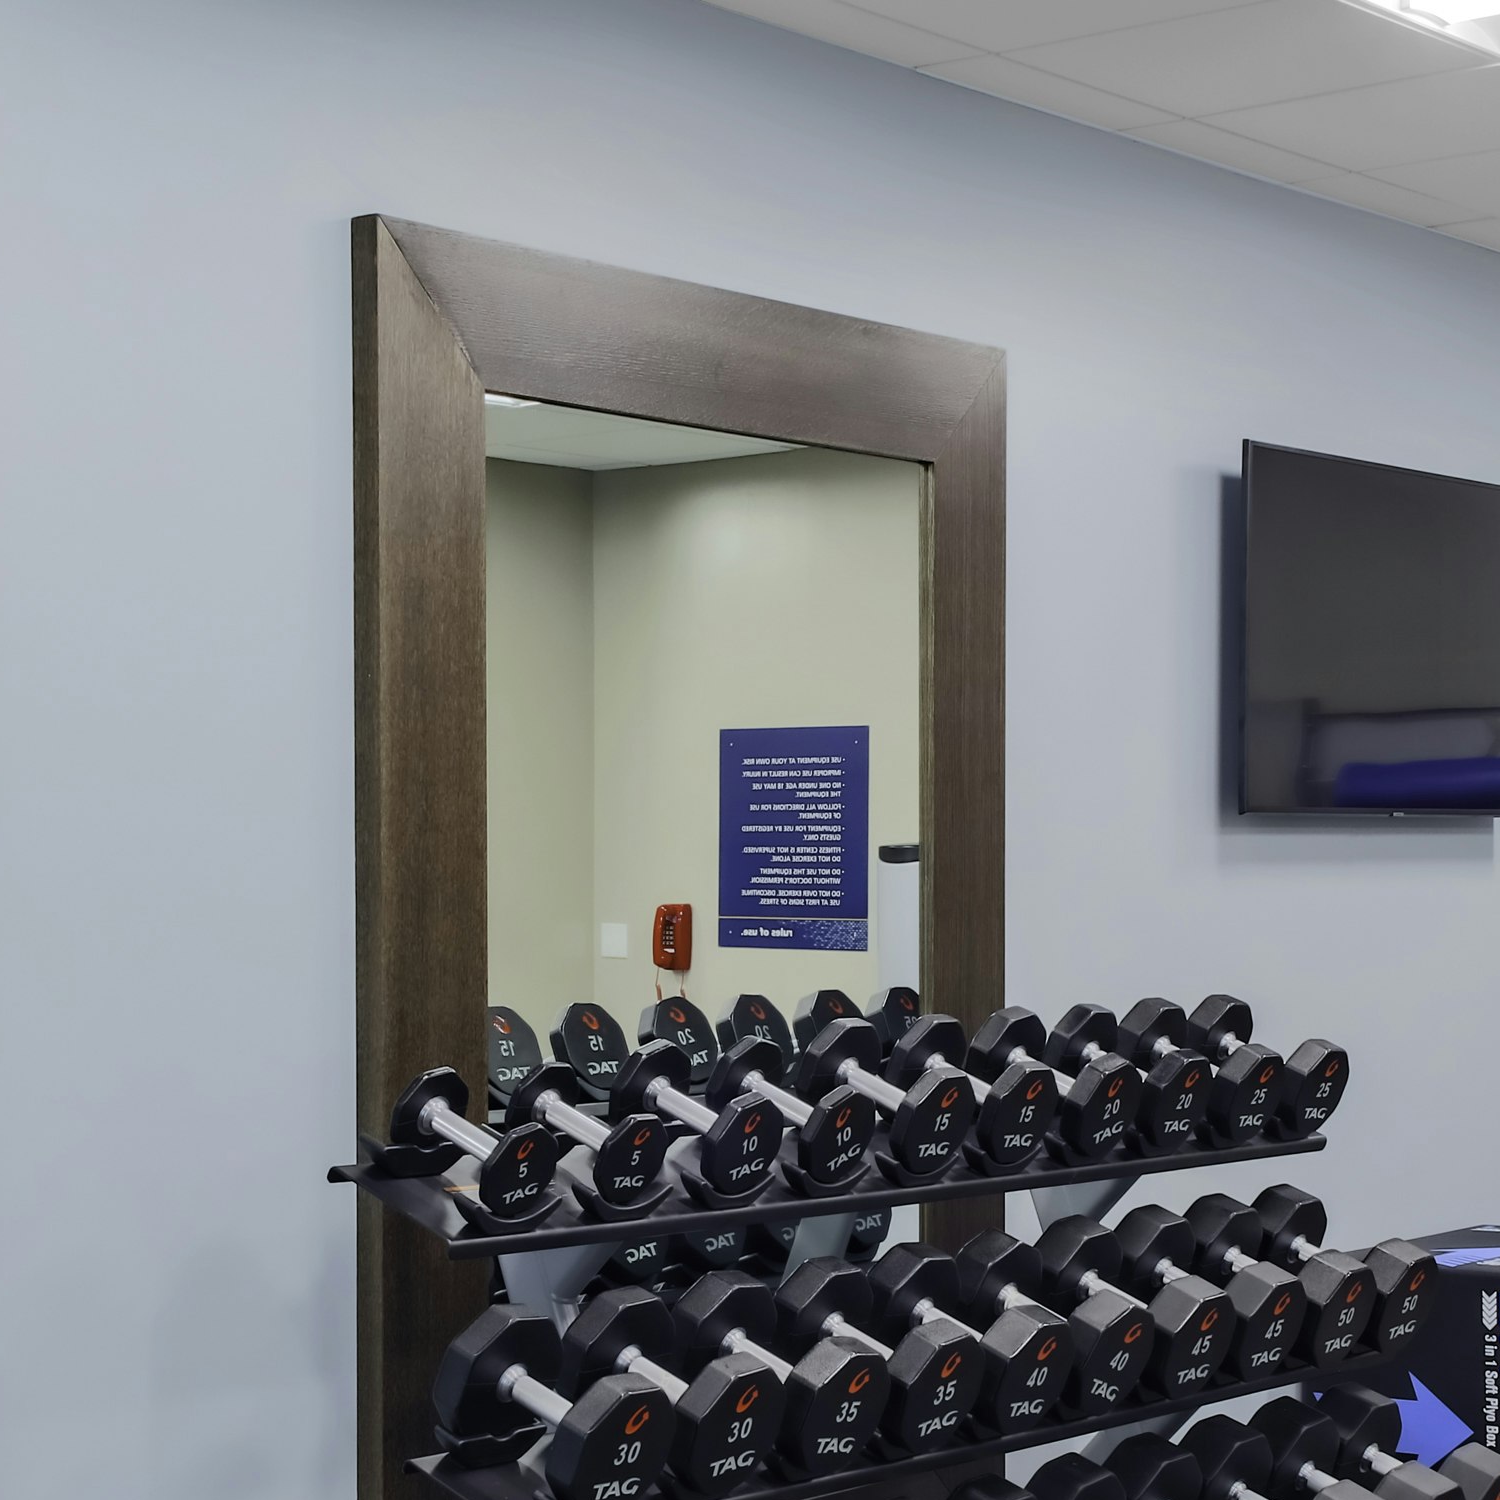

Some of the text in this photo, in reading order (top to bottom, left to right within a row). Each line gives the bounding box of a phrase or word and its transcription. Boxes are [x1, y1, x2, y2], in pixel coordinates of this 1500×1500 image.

[1251, 1088, 1267, 1104] 25
[1316, 1083, 1332, 1098] 25
[1103, 1099, 1121, 1120] 20
[1176, 1093, 1193, 1109] 20
[934, 1113, 951, 1132] 15
[1019, 1105, 1035, 1123] 15
[1239, 1113, 1263, 1127] TAG
[1304, 1107, 1327, 1119] TAG
[1093, 1120, 1124, 1144] TAG
[1164, 1119, 1190, 1133] TAG
[743, 1136, 758, 1154] 10
[837, 1127, 851, 1146] 10
[1004, 1134, 1033, 1148] TAG
[631, 1150, 642, 1165] 5
[827, 1144, 860, 1171] TAG
[918, 1142, 949, 1157] TAG
[519, 1162, 527, 1178] 5
[729, 1158, 764, 1181] TAG
[613, 1175, 645, 1188] TAG
[503, 1183, 538, 1204] TAG
[1401, 1295, 1418, 1314] 50
[1338, 1307, 1355, 1327] 50
[1265, 1319, 1284, 1340] 45
[1389, 1320, 1416, 1340] TAG
[1192, 1335, 1212, 1356] 45
[1325, 1334, 1353, 1353] TAG
[1485, 1345, 1497, 1356] in
[1110, 1351, 1129, 1371] 40
[1251, 1348, 1282, 1367] TAG
[1027, 1367, 1048, 1387] 40
[1177, 1364, 1210, 1384] TAG
[1485, 1370, 1498, 1394] Soft
[934, 1380, 956, 1405] 35
[1091, 1379, 1119, 1402] TAG
[836, 1401, 861, 1422] 35
[1010, 1399, 1044, 1417] TAG
[1483, 1398, 1498, 1422] Plyo
[728, 1417, 753, 1442] 30
[918, 1411, 958, 1436] TAG
[817, 1438, 855, 1454] TAG
[1486, 1425, 1499, 1447] Box
[614, 1441, 641, 1465] 30
[710, 1451, 755, 1476] TAG
[593, 1477, 641, 1500] TAG
